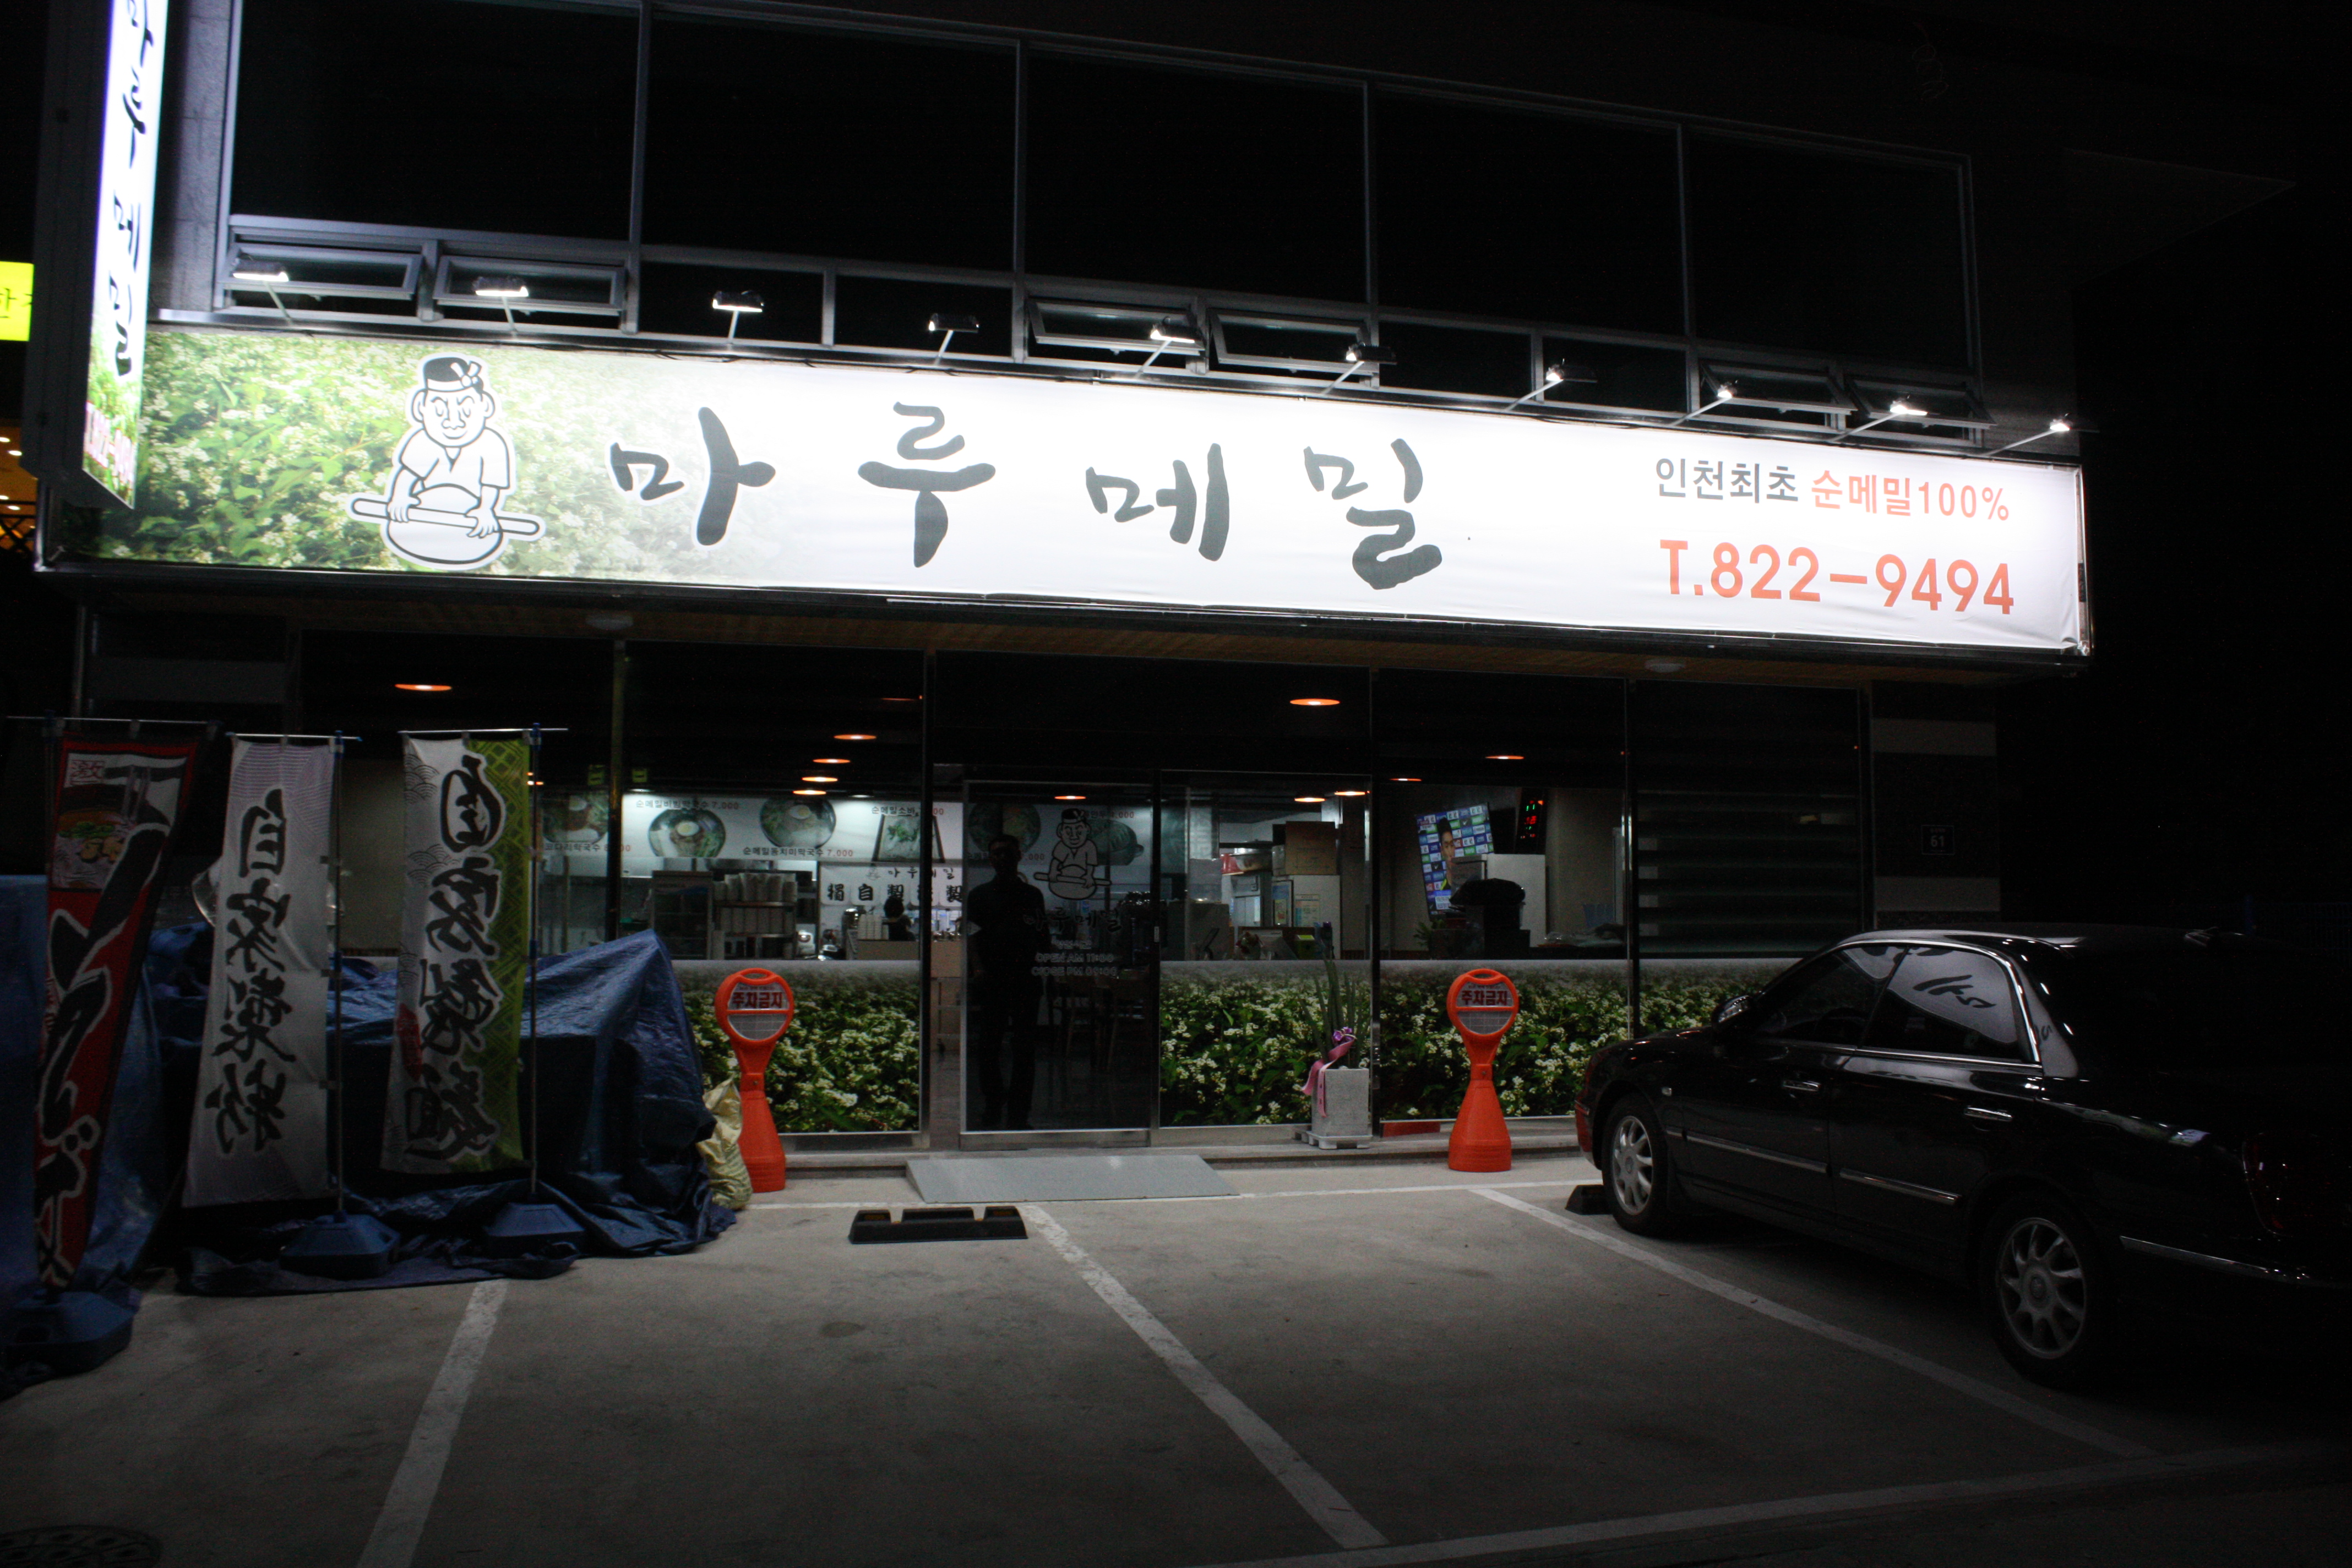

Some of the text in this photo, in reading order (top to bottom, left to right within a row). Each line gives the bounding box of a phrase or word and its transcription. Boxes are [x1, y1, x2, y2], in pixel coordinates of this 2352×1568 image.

[1656, 457, 2011, 521] 인천최초 순메밀100%
[732, 991, 783, 1010] 주차금지
[1462, 990, 1507, 1006] 주차금지
